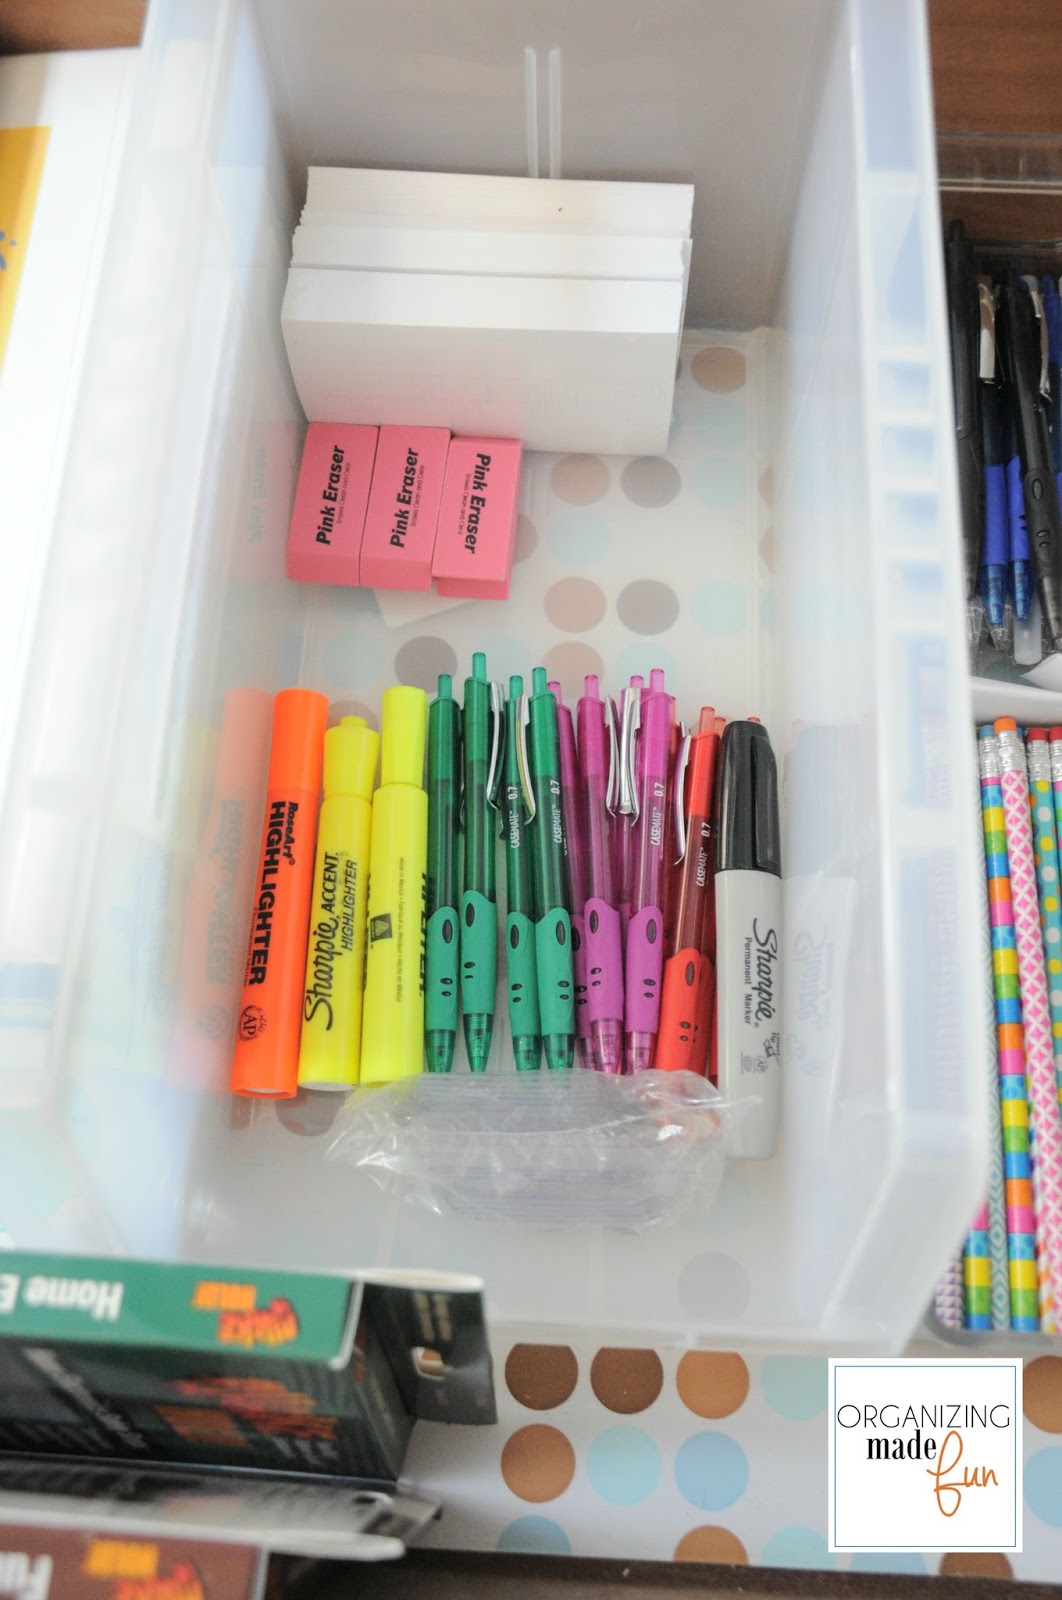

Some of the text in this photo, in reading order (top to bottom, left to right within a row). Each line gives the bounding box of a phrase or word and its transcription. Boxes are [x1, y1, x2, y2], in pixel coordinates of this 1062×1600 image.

[315, 445, 346, 545] Pink Eraser
[390, 448, 419, 548] Pink Eraser
[464, 453, 492, 554] Pink Eraser
[508, 786, 520, 848] CASEMATE 0.7
[550, 780, 563, 843] CASEMATE 0.7
[650, 782, 665, 846] CASEMATE 0.7
[696, 822, 711, 887] CASEMATE 0.7
[249, 801, 286, 986] HIGHLIGHTER
[341, 859, 357, 952] HIGHLIGHTER
[304, 917, 342, 1031] Sharpie
[744, 937, 753, 1025] Permanent Marker
[752, 918, 778, 1022] Sharpie
[23, 1275, 125, 1322] Home
